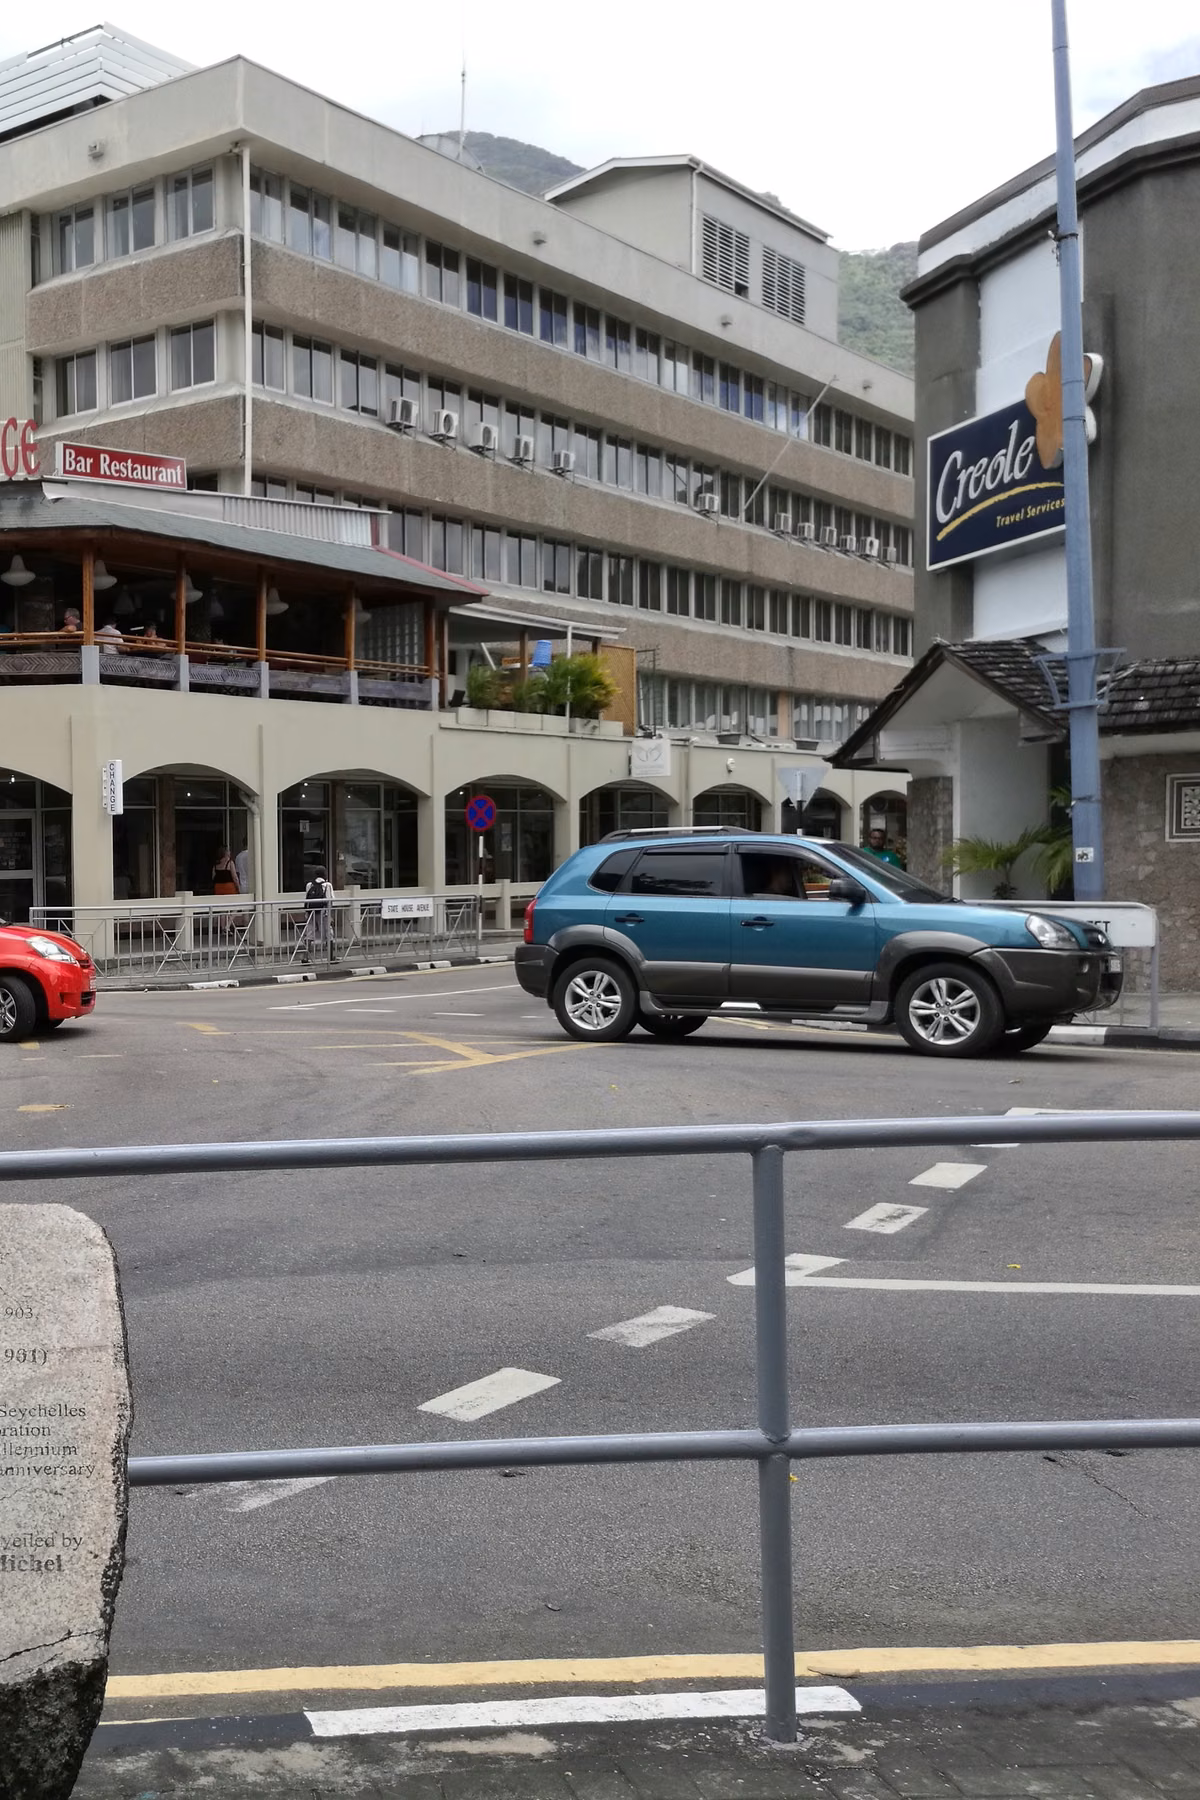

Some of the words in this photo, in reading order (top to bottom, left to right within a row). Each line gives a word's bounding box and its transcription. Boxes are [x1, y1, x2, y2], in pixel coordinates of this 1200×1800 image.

[65, 448, 93, 473] Bar
[100, 453, 183, 485] Restaurant
[936, 419, 1035, 524] Creole
[996, 508, 1024, 528] Travel
[1027, 498, 1065, 519] Services
[387, 904, 399, 912] STATE
[402, 904, 414, 912] HOUSE
[416, 903, 430, 911] AVENUE
[62, 1532, 83, 1551] by
